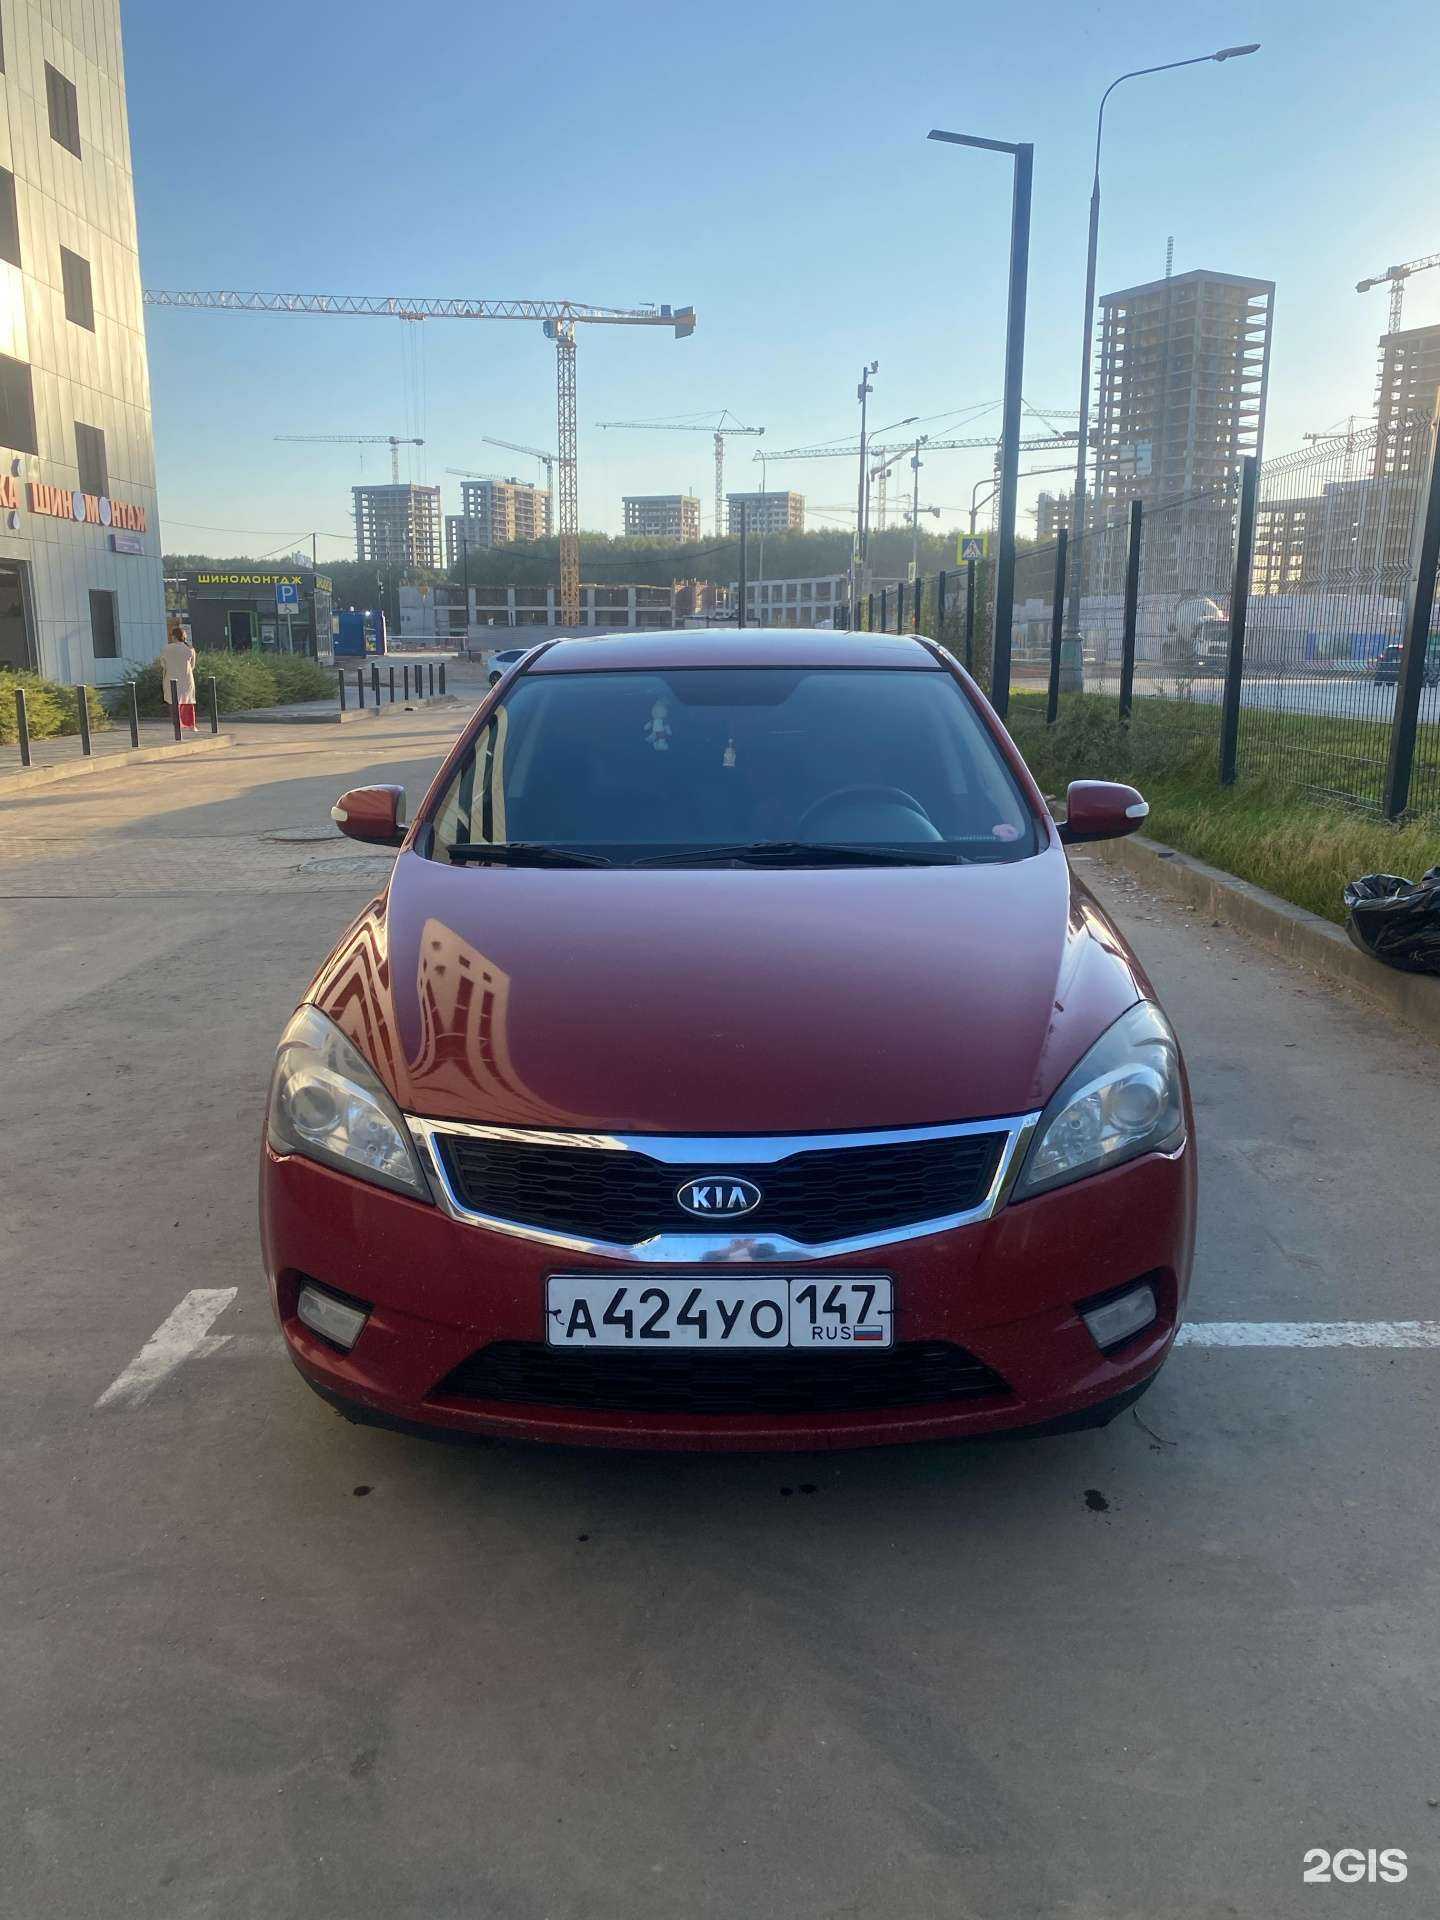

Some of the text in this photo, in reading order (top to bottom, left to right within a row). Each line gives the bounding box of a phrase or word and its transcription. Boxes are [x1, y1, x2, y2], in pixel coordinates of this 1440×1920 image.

[29, 481, 146, 532] ШИНОМОНТАЖ
[198, 574, 303, 585] ШИНОМОНТАЖ
[282, 585, 293, 603] P
[691, 1186, 748, 1209] KIA
[566, 1284, 876, 1340] А424УО 147
[812, 1326, 852, 1341] RUS
